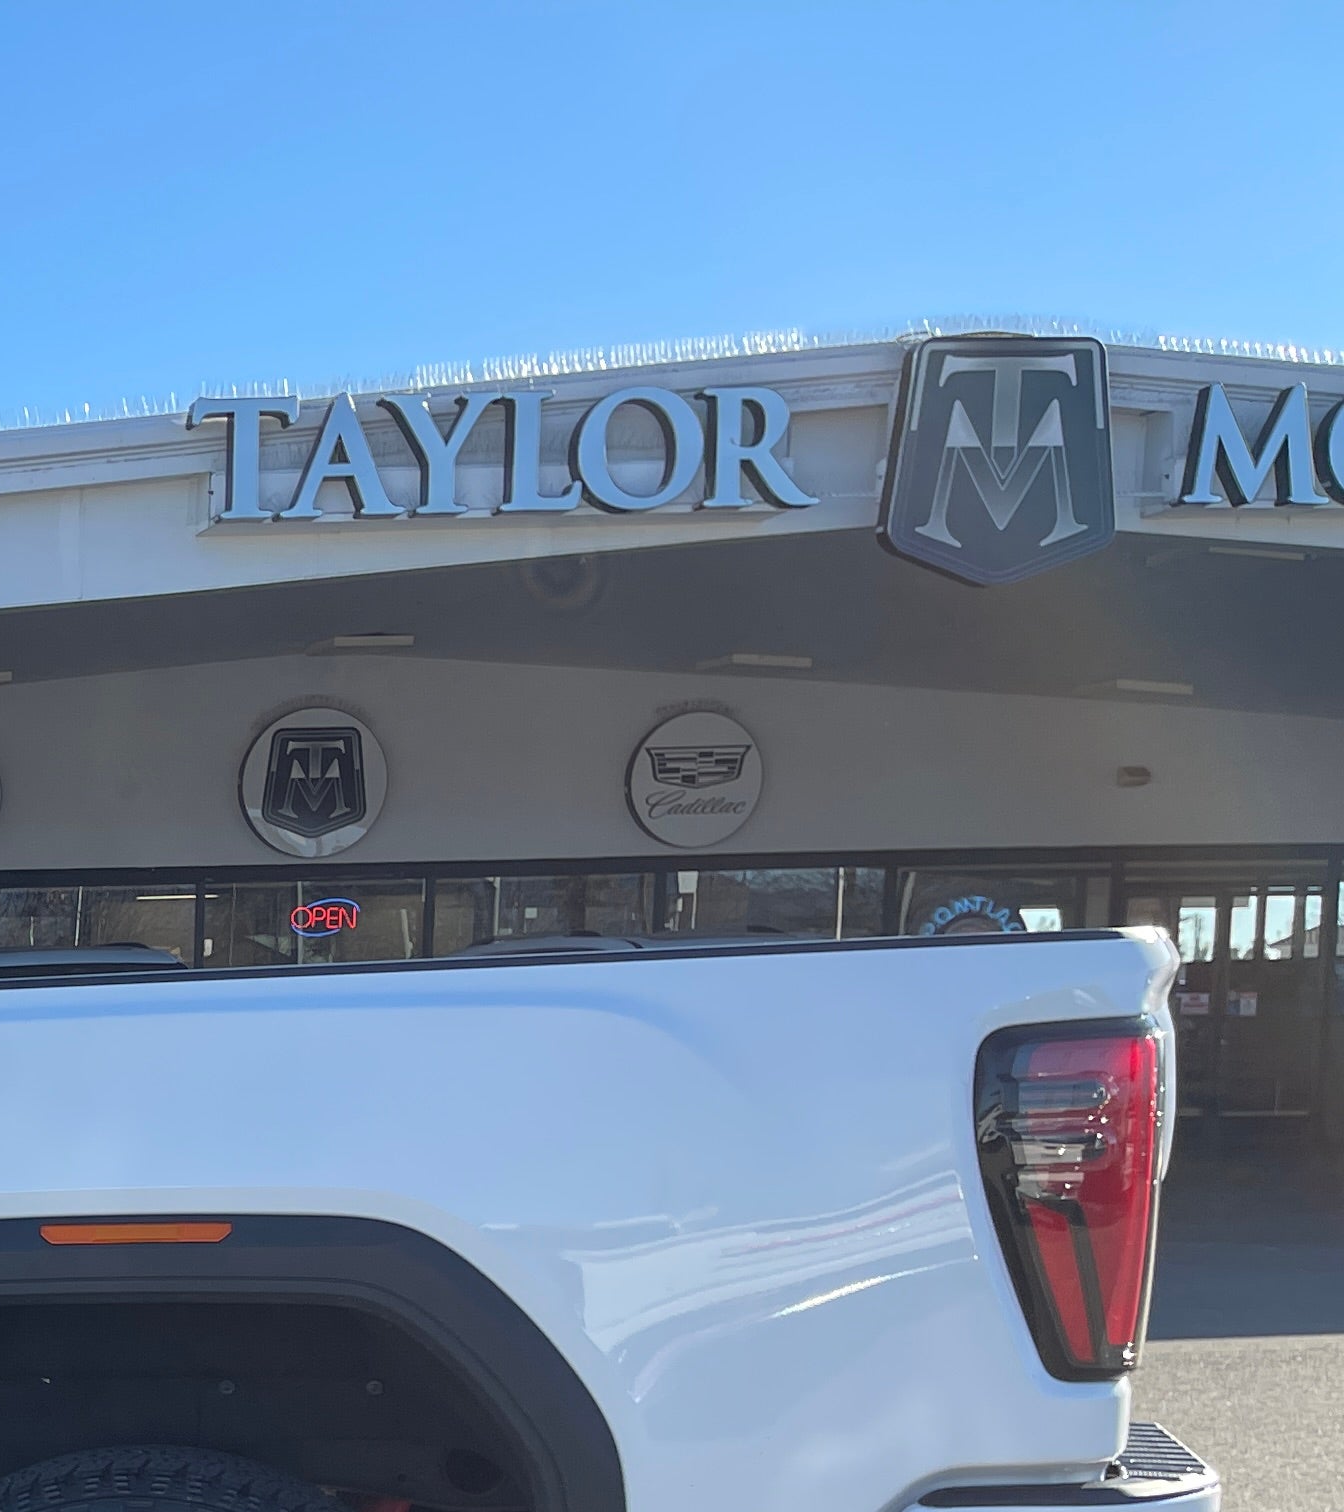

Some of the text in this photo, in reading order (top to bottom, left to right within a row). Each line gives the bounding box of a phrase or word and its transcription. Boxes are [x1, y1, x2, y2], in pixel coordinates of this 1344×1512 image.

[188, 380, 1344, 521] TAYLOR M
[645, 790, 746, 820] Cadillac
[290, 906, 357, 930] OPEN
